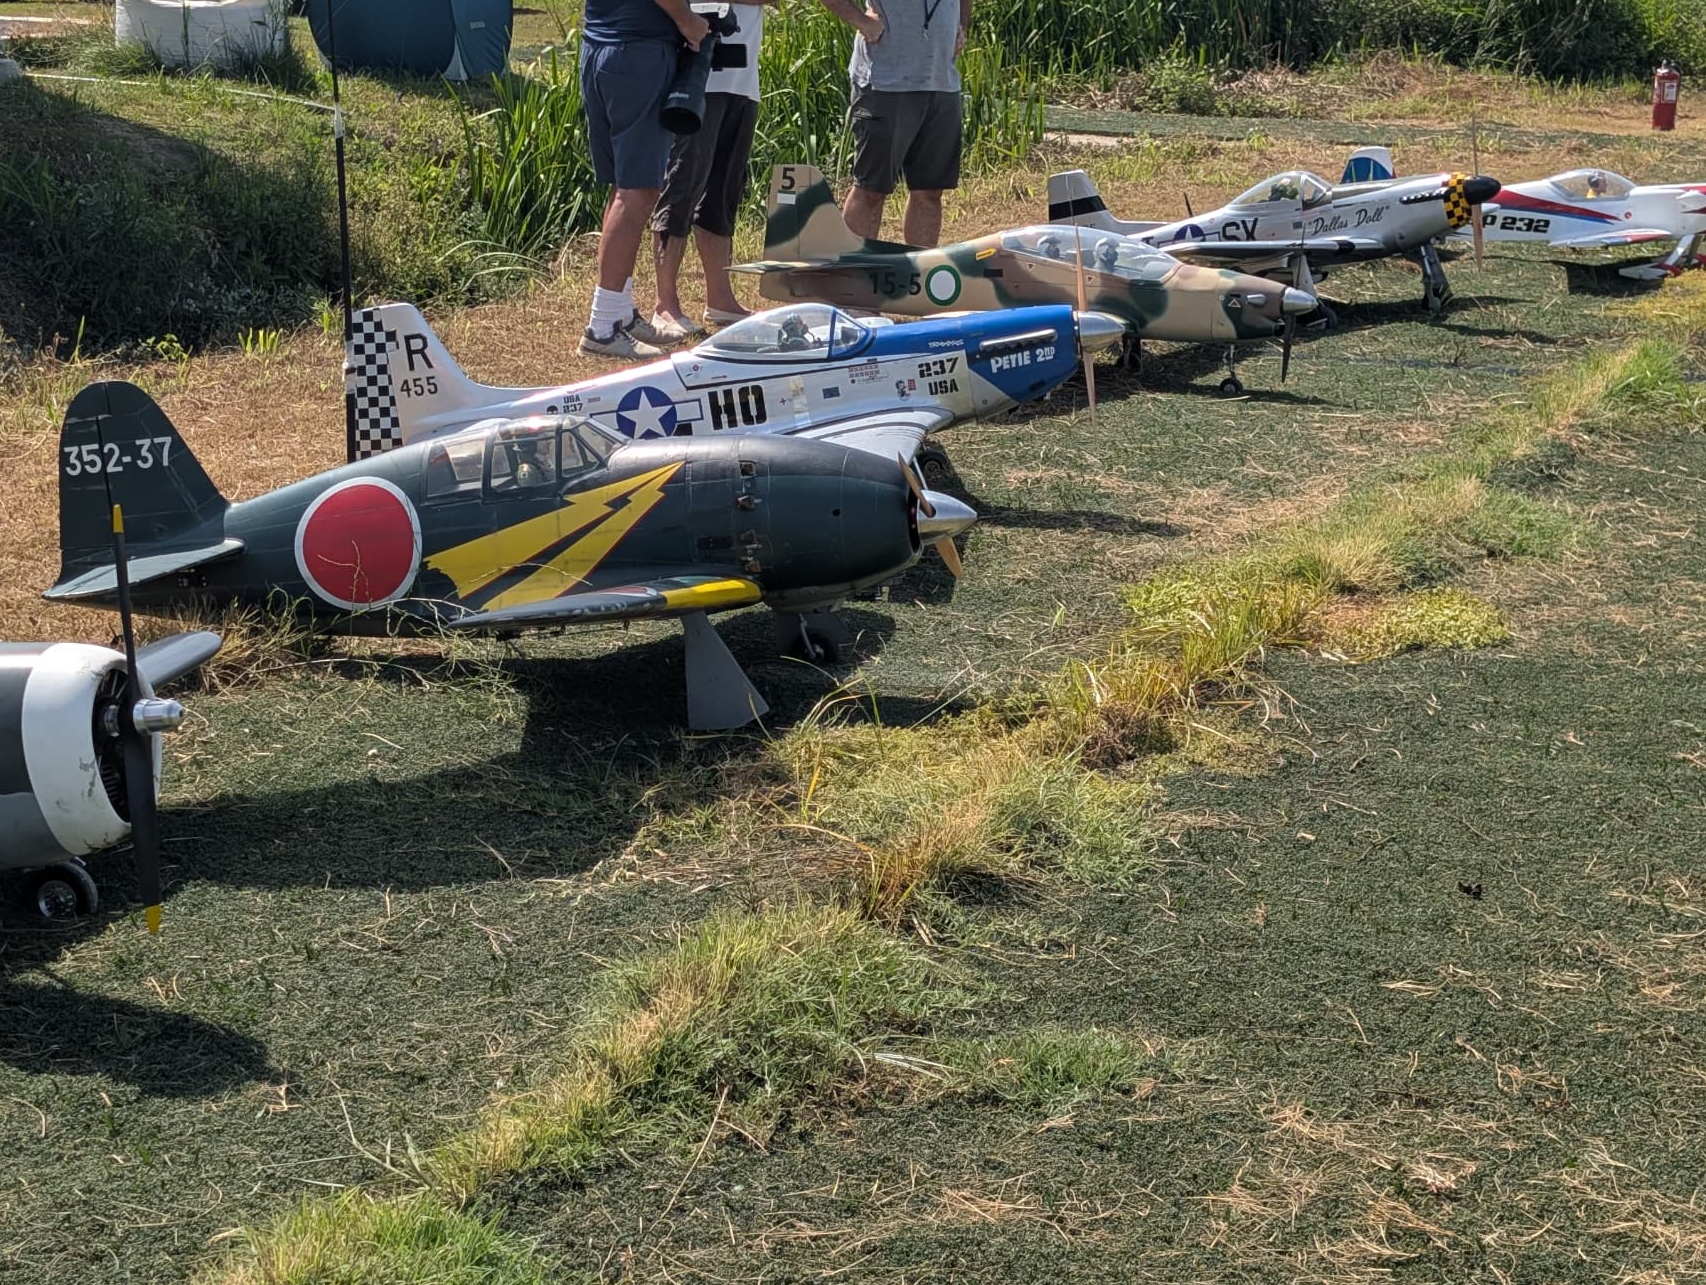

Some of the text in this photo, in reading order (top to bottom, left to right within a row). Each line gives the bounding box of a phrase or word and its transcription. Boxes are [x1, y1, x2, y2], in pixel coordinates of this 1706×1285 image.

[781, 167, 796, 190] 5
[1500, 216, 1551, 233] 232
[403, 333, 434, 371] R
[917, 357, 959, 378] 237
[400, 376, 438, 398] 455
[928, 379, 959, 395] USA
[563, 402, 583, 413] 237
[63, 436, 172, 476] 352-37
